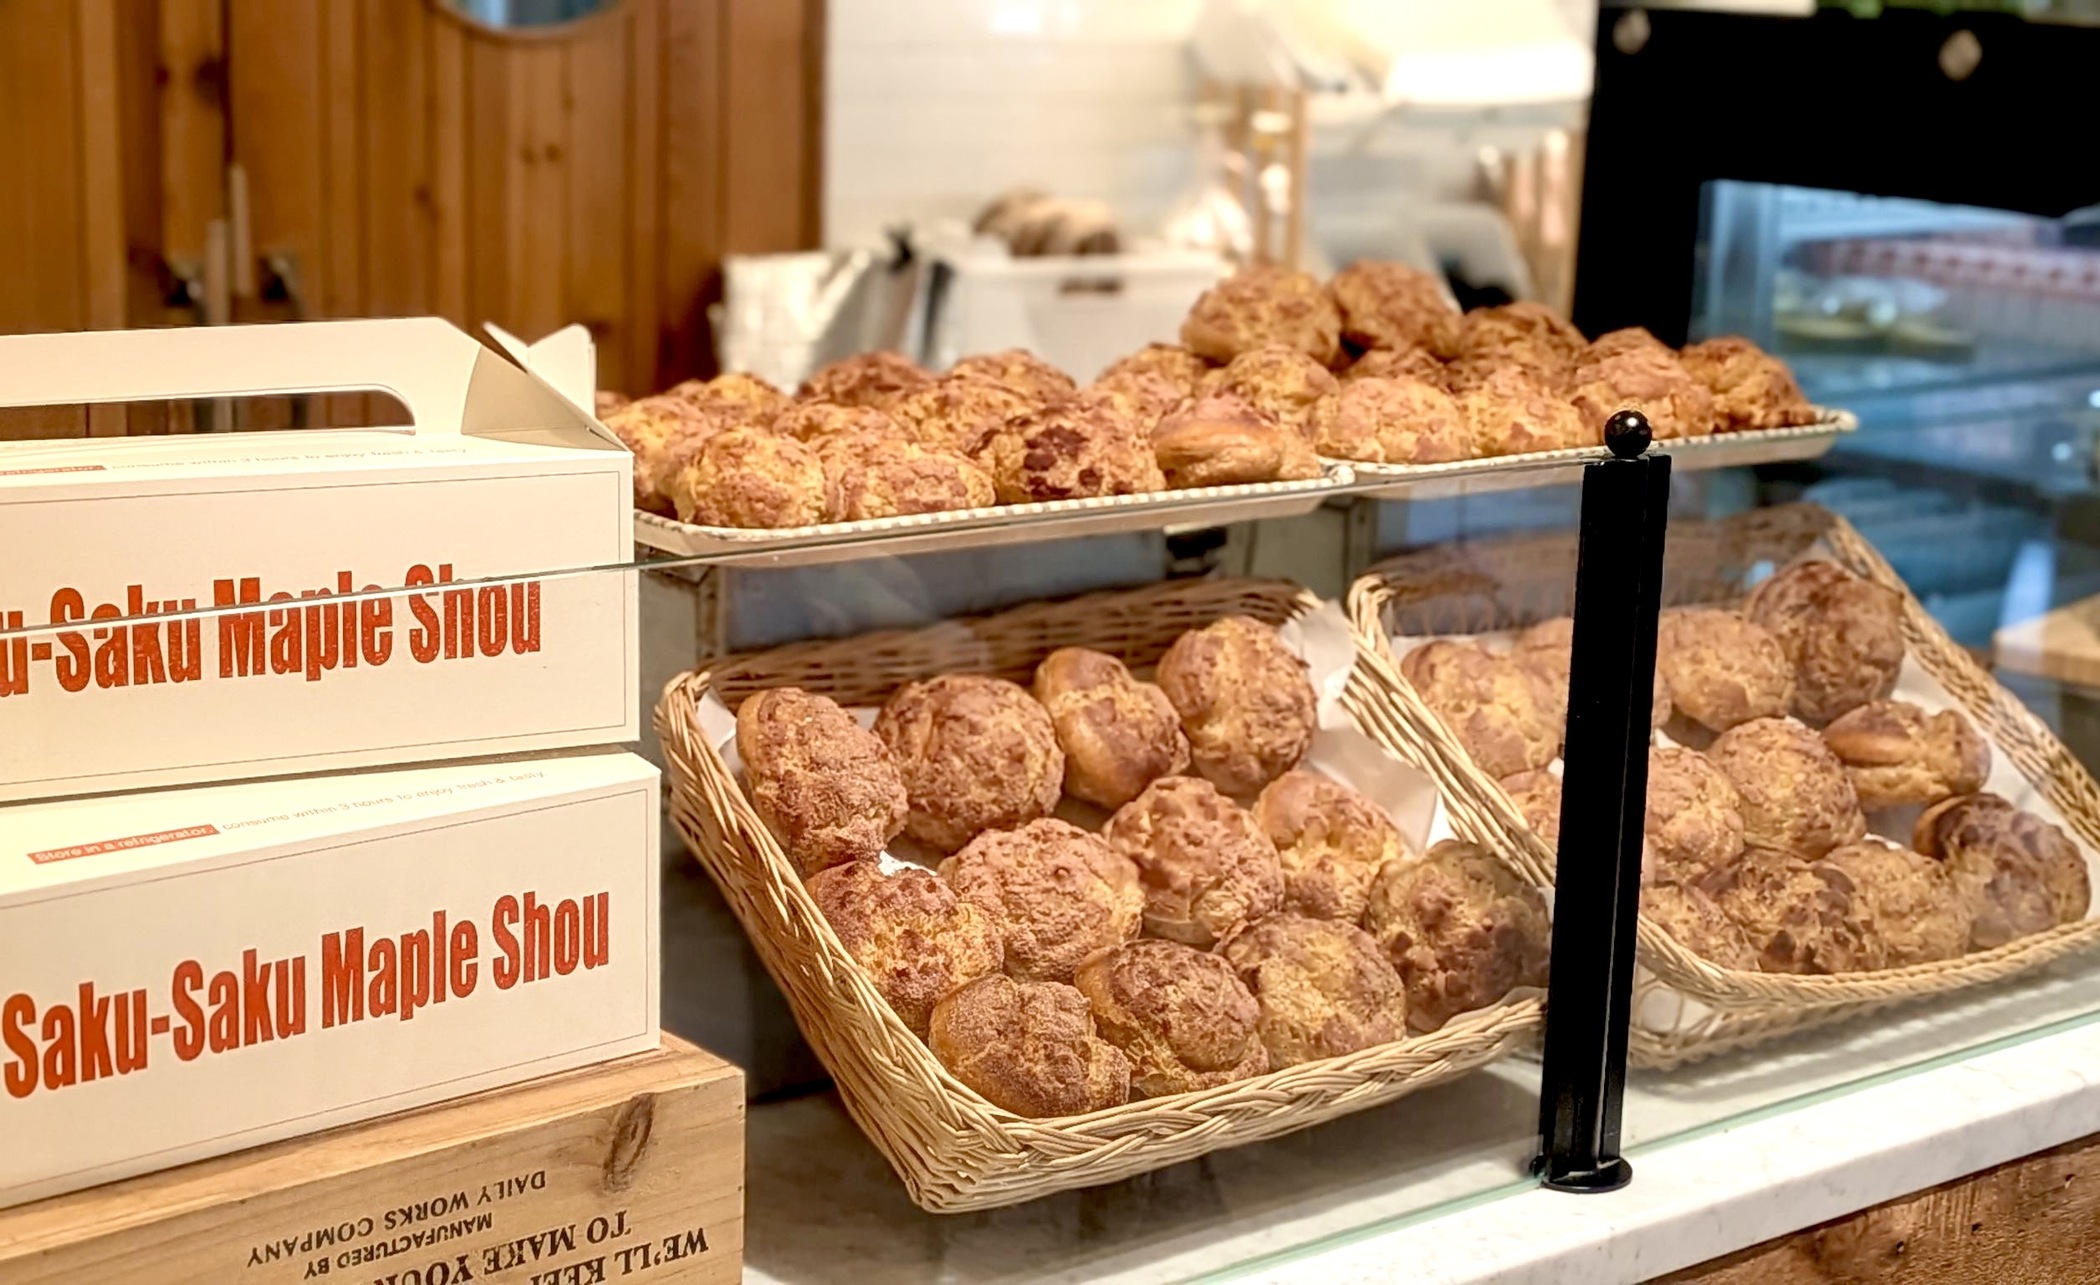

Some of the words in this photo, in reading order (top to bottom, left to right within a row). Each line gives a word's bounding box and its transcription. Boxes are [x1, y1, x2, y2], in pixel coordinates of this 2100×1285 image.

[213, 570, 393, 682] Maple
[404, 563, 541, 664] Shou
[34, 847, 83, 862] Store
[84, 843, 102, 856] in
[104, 842, 116, 852] a
[222, 813, 290, 830] consume
[292, 804, 337, 819] within
[338, 802, 351, 811] 3
[351, 796, 394, 809] hours
[396, 793, 413, 801] to
[416, 785, 454, 799] enjoy
[2, 948, 306, 1098] Saku-Saku
[321, 909, 479, 1030] Maple
[492, 890, 610, 991] Shou
[384, 1191, 469, 1230] WORKS
[476, 1170, 546, 1206] DAILY
[246, 1217, 374, 1268] COMPANY
[336, 1211, 493, 1269] MANUFACTURED
[482, 1223, 577, 1276] MAKE
[586, 1209, 632, 1245] TO
[614, 1227, 709, 1276] WE'LL
[303, 1256, 330, 1280] BY
